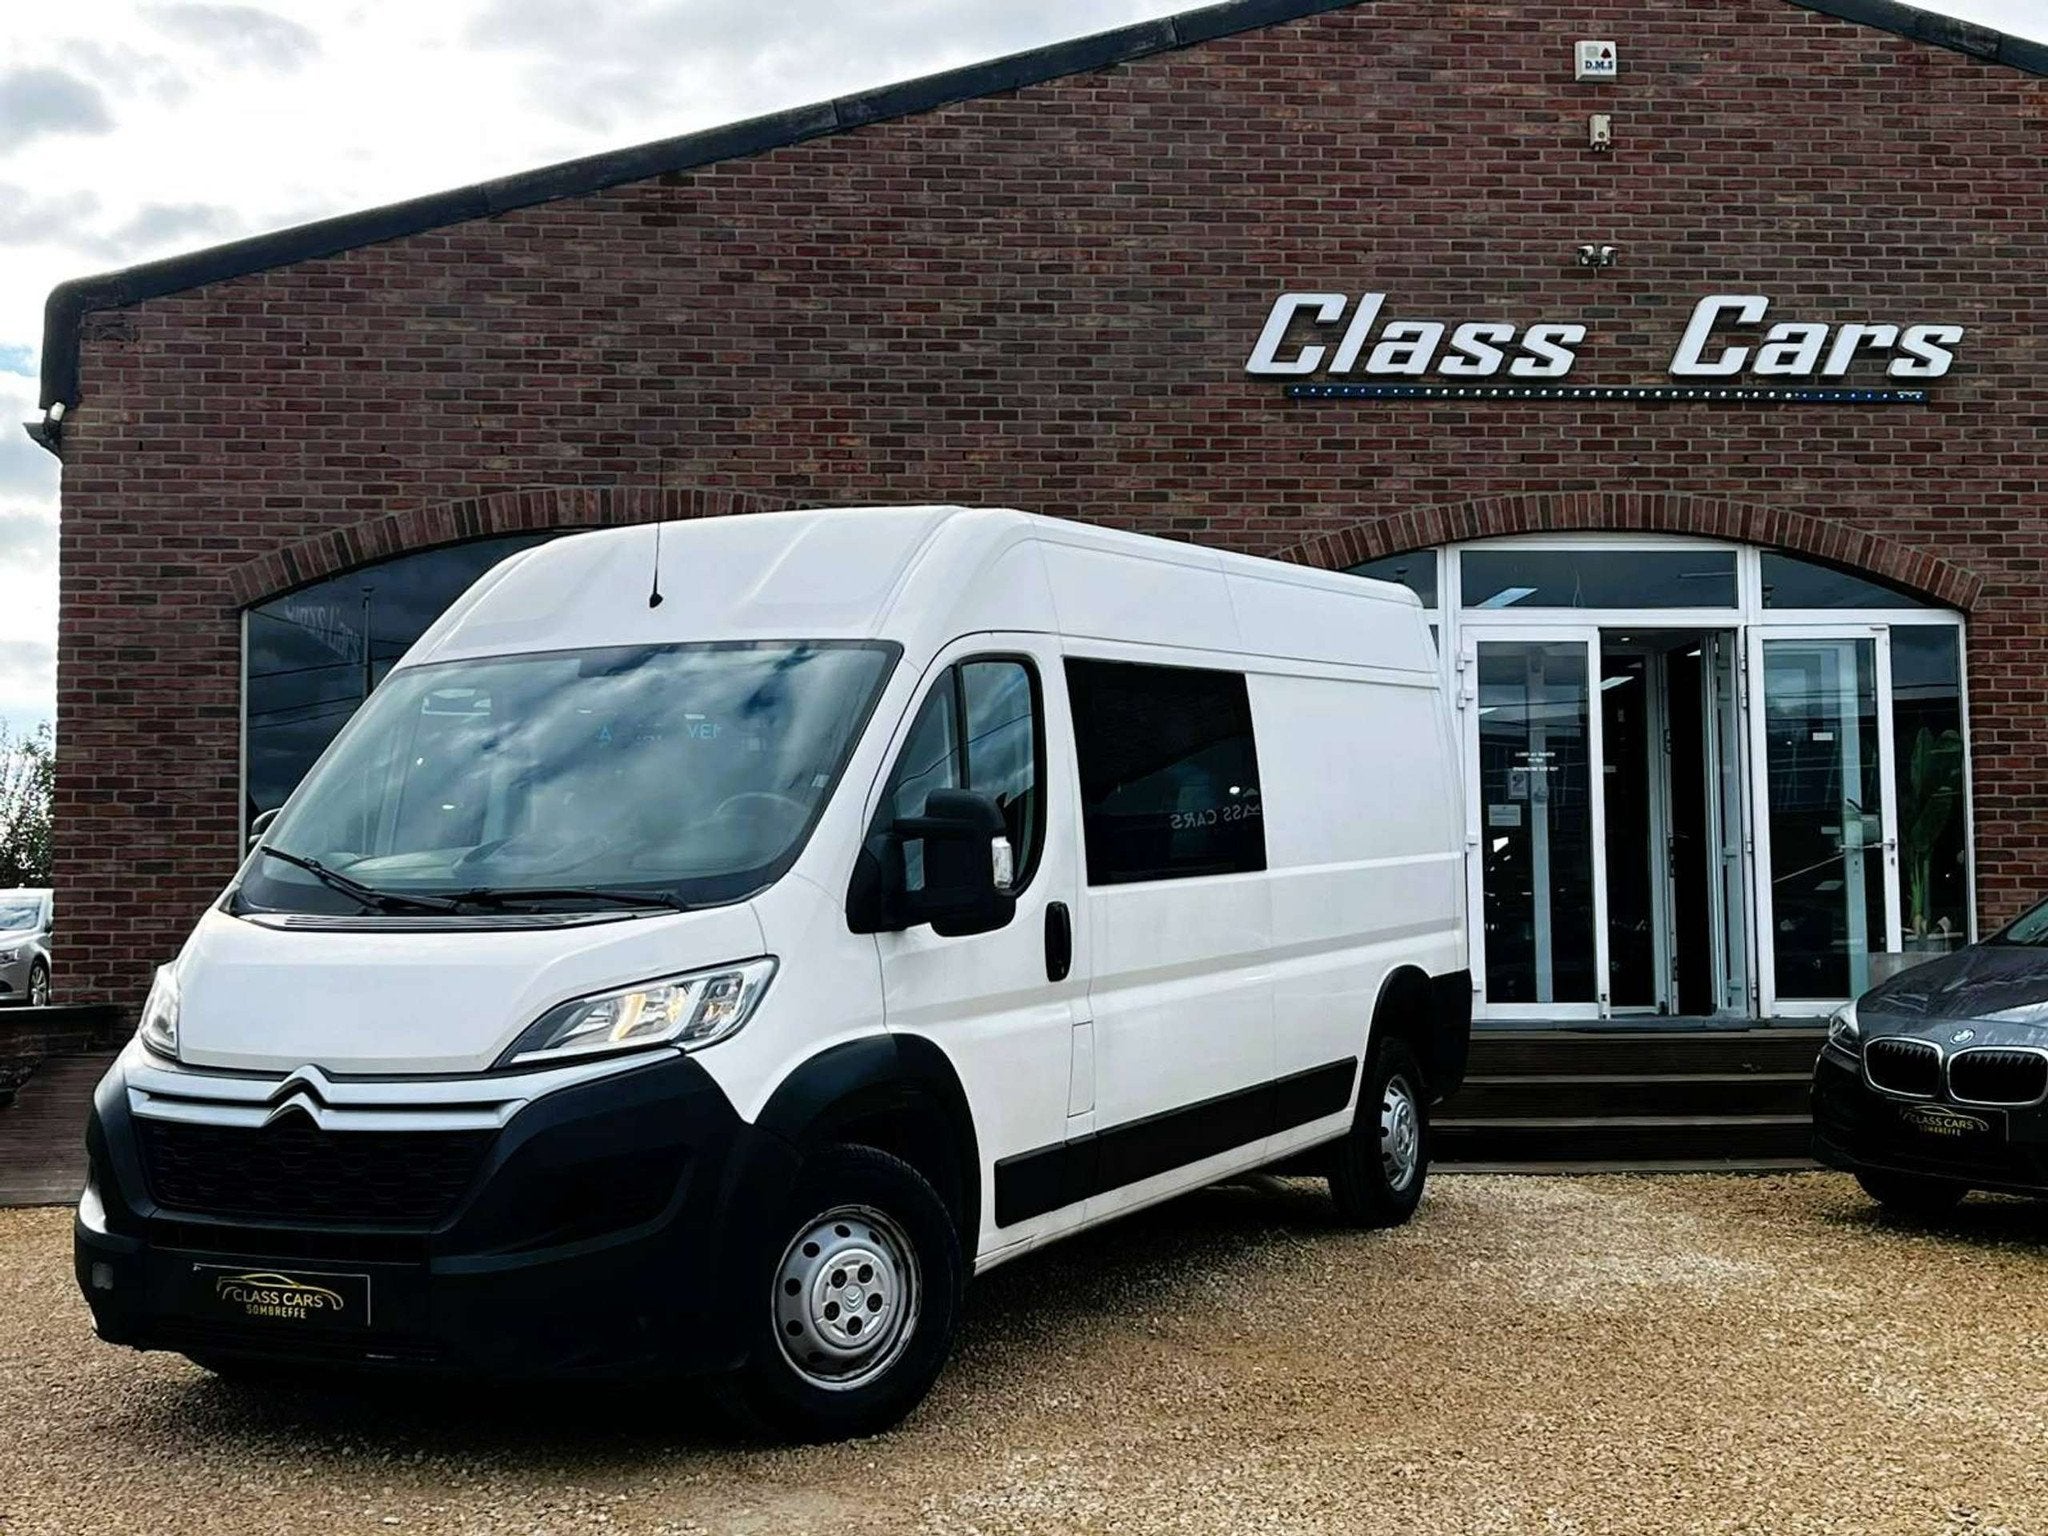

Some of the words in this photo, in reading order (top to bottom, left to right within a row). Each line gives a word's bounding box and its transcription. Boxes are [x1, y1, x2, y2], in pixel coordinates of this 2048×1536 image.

[1245, 292, 1588, 377] Class
[1668, 294, 1965, 378] Cars
[1943, 1118, 1975, 1131] CARS
[233, 1289, 280, 1305] CLASS
[282, 1292, 324, 1308] CARS
[245, 1304, 307, 1319] SOMBREFFE
